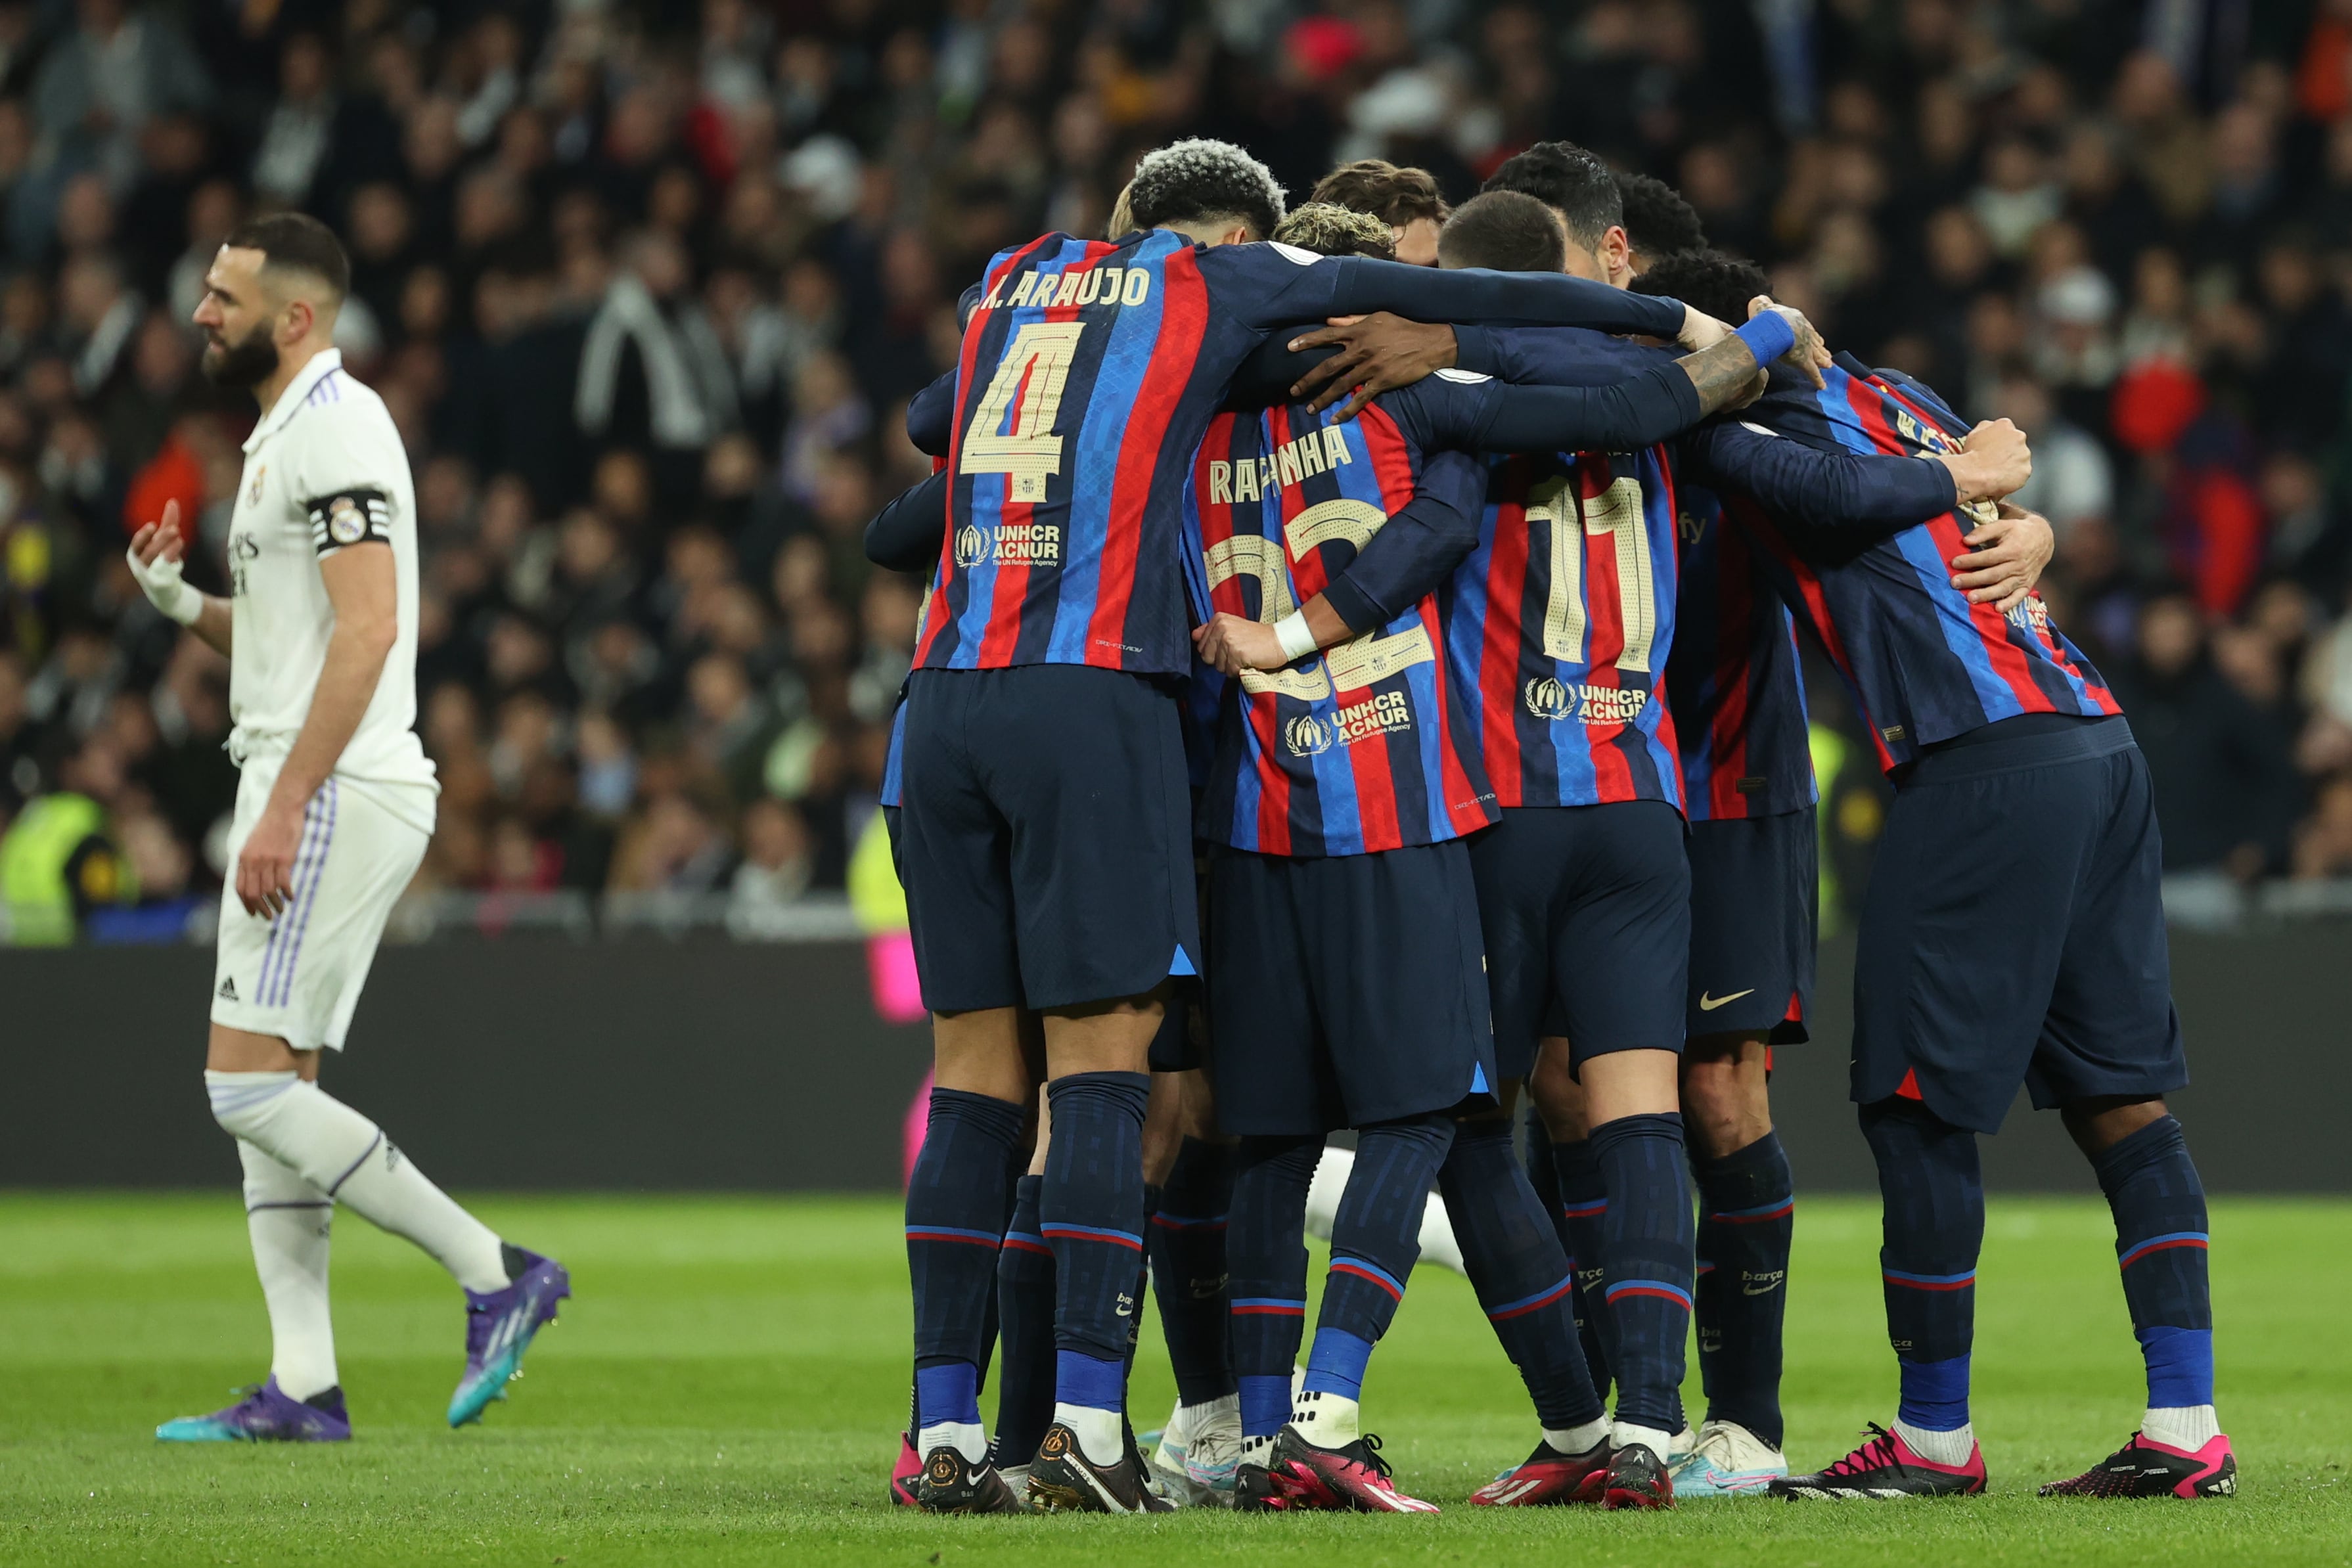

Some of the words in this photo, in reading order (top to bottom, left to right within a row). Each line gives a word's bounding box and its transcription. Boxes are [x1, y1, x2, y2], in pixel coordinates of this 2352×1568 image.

[1006, 267, 1150, 307] ARAUJO
[960, 321, 1087, 503] 4
[994, 525, 1060, 542] UNHCR
[992, 542, 1058, 558] ACNUR
[1034, 559, 1058, 568] Agency
[1525, 475, 1655, 673] 11
[1579, 684, 1646, 705] UNHCR
[1330, 691, 1405, 727] UNHCR
[1338, 707, 1410, 743] ACNUR
[1362, 727, 1388, 740] Refugee
[1388, 724, 1411, 733] Agency
[1742, 1270, 1783, 1282] barça
